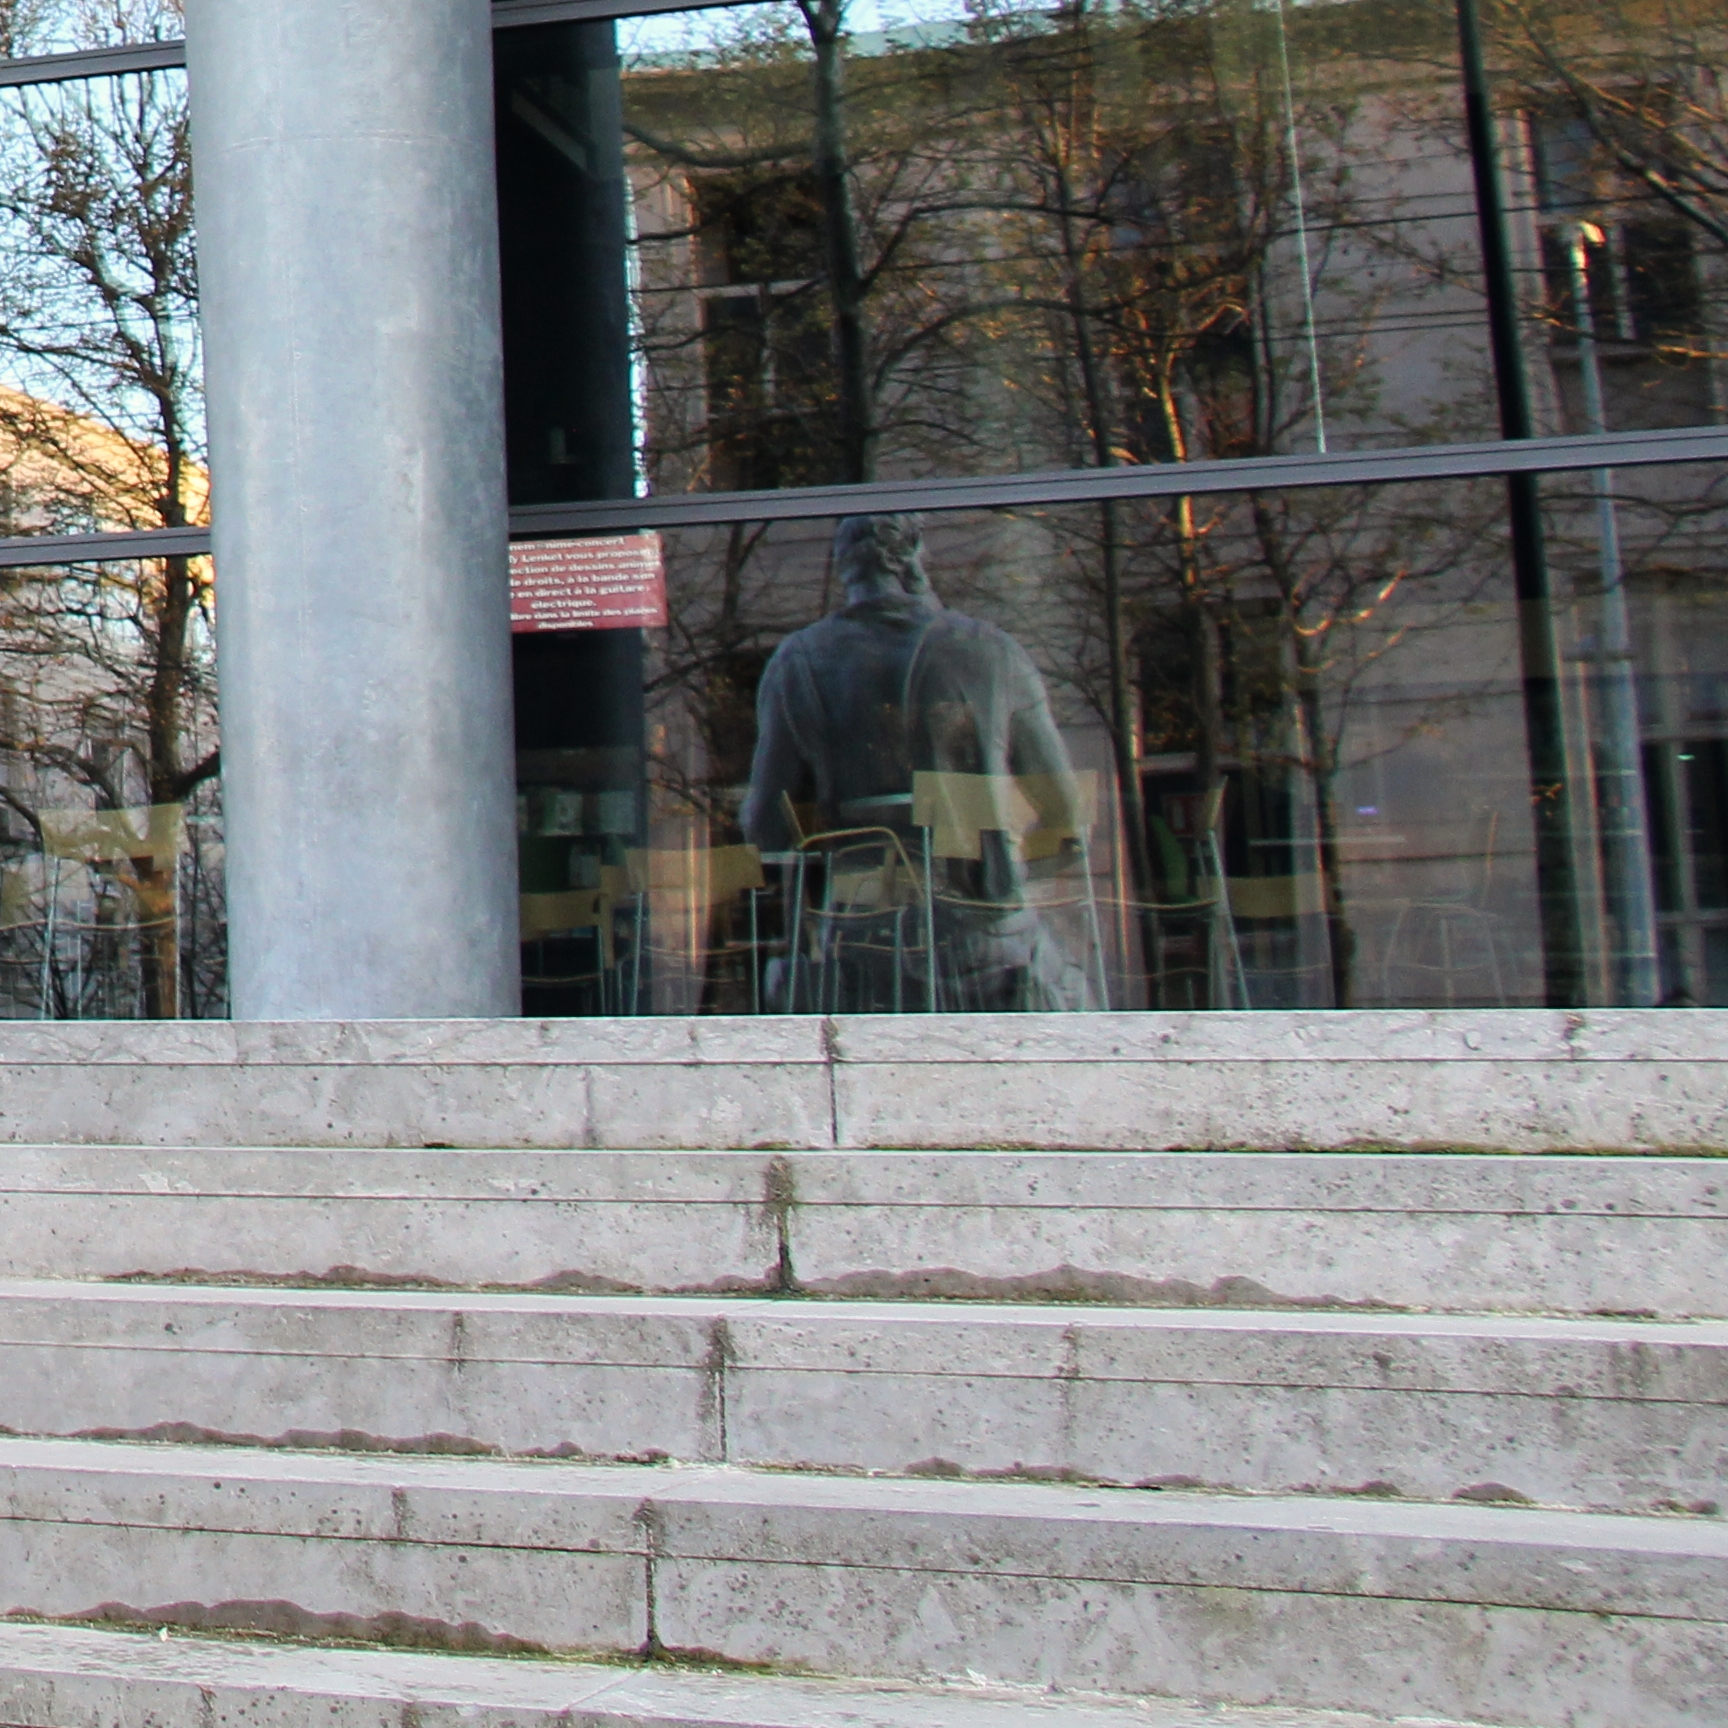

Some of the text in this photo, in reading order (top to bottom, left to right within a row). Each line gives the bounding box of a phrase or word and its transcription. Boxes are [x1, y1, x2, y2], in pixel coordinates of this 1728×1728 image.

[565, 552, 594, 560] vous
[551, 564, 566, 572] de
[569, 562, 615, 571] dessins
[577, 574, 589, 583] la
[592, 573, 630, 582] bande
[632, 572, 655, 580] son
[535, 587, 572, 597] direct
[585, 585, 597, 595] la
[534, 611, 559, 620] dans
[560, 610, 570, 619] la
[572, 609, 601, 618] limite
[603, 608, 622, 616] des
[624, 606, 658, 616] places
